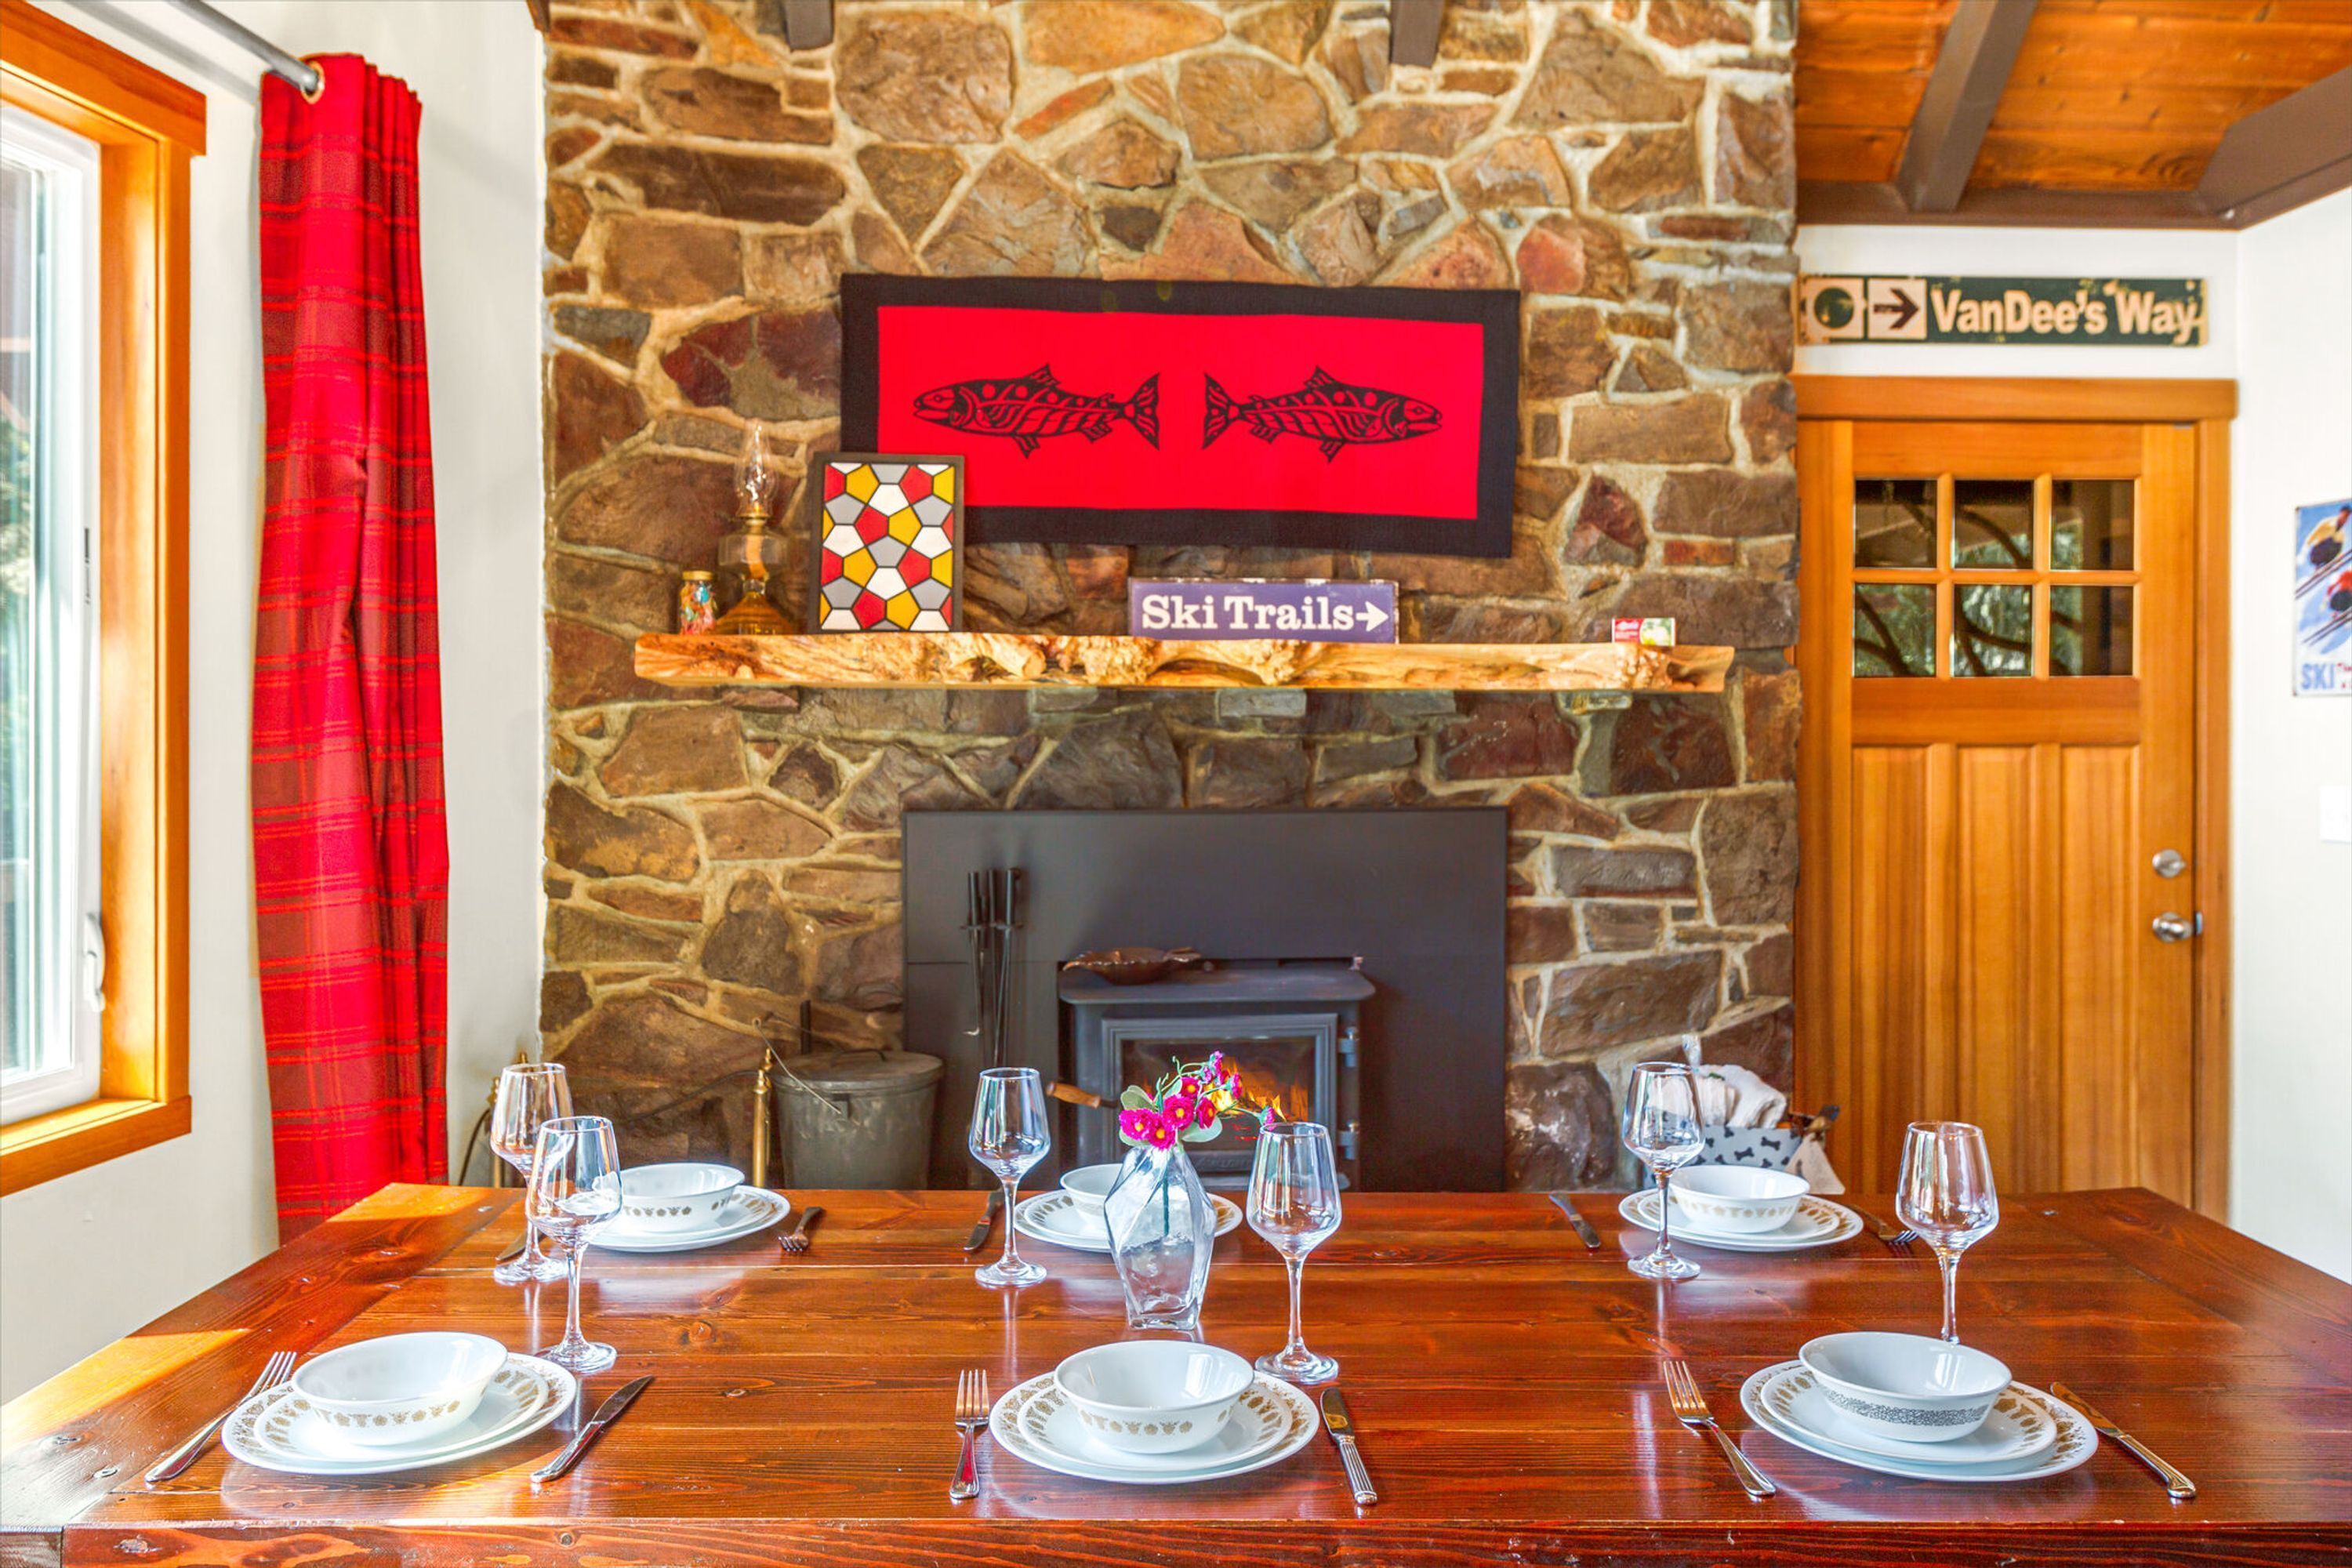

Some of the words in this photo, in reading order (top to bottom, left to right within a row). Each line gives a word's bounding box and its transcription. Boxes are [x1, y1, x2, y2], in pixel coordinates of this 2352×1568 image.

[1930, 289, 2107, 335] VanDee's
[2114, 289, 2198, 345] Way
[1142, 595, 1218, 630] Ski
[1224, 596, 1354, 630] Trails
[2301, 662, 2335, 690] SKI
